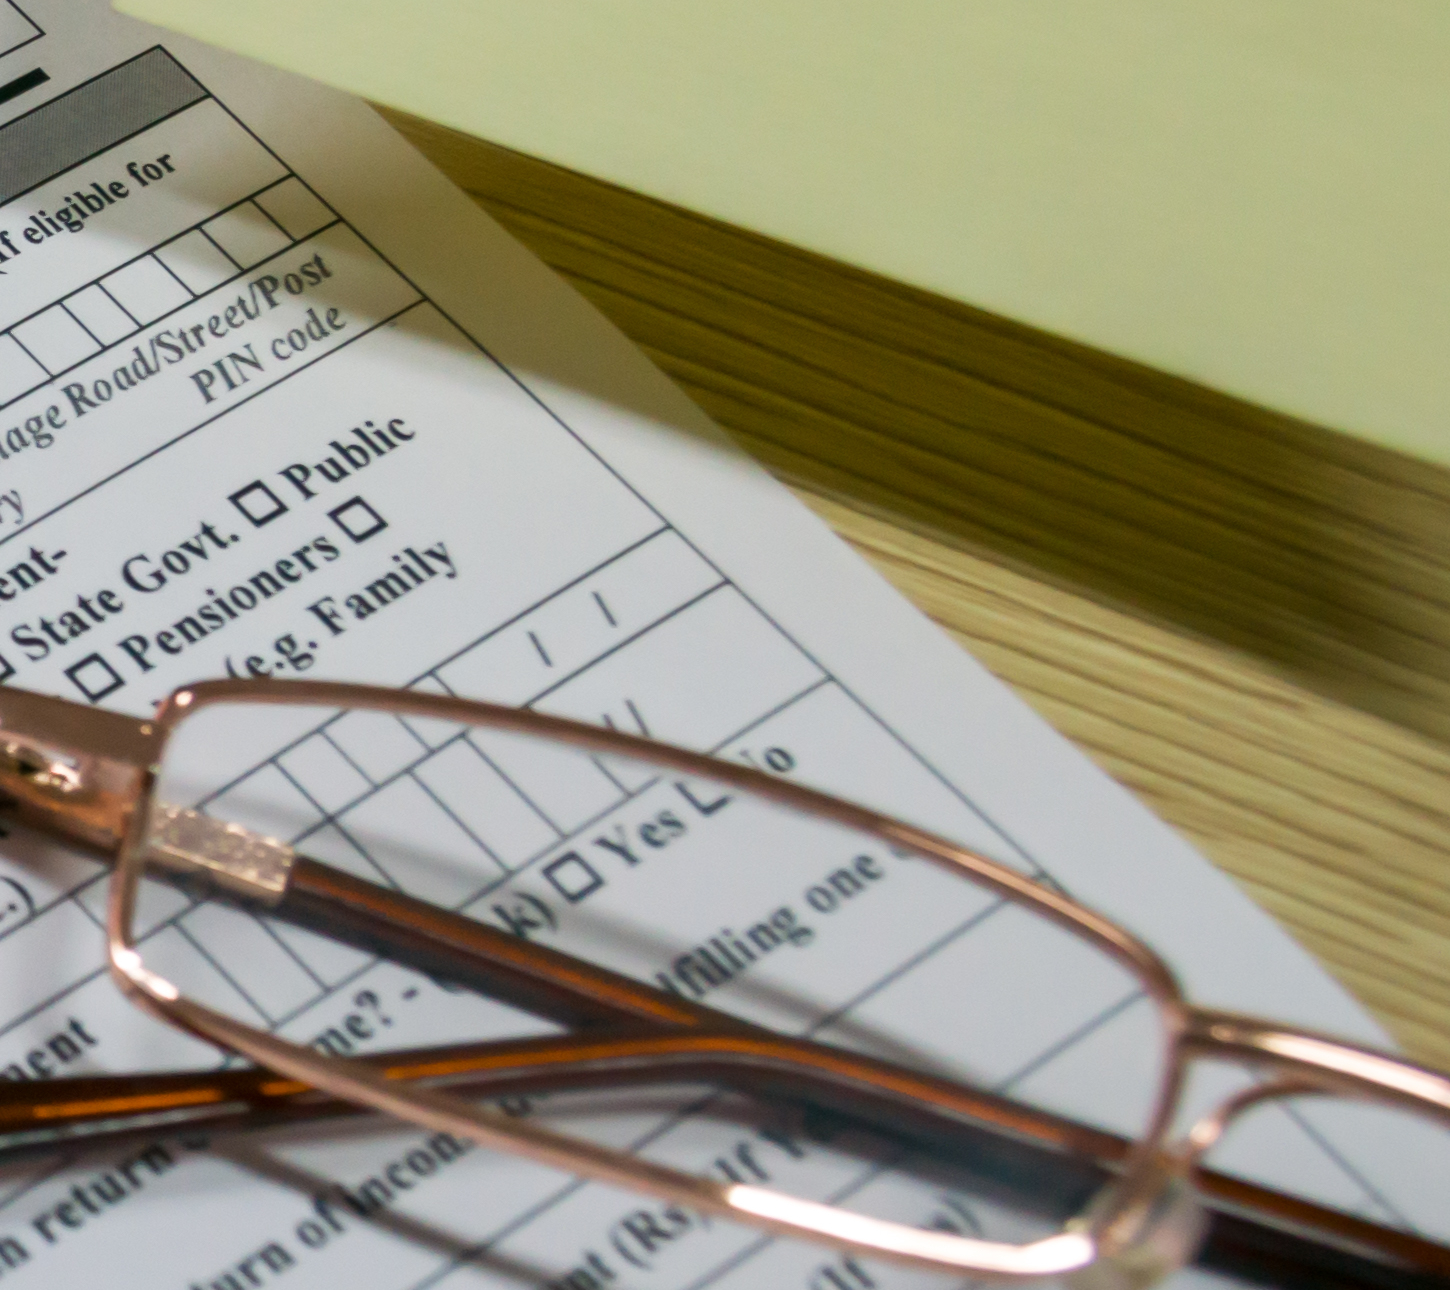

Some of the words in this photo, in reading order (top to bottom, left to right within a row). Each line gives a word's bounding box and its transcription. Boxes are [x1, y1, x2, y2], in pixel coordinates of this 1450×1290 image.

[19, 177, 132, 247] eligible
[122, 150, 178, 190] for
[56, 250, 335, 421] Road/Street/Post
[185, 339, 287, 418] PIN
[267, 303, 348, 375] code
[7, 586, 126, 664] State
[118, 518, 243, 596] Govt.
[274, 415, 418, 503] Public
[302, 538, 460, 639] Family
[113, 532, 342, 675] Pensioners
[590, 806, 689, 870] Yes
